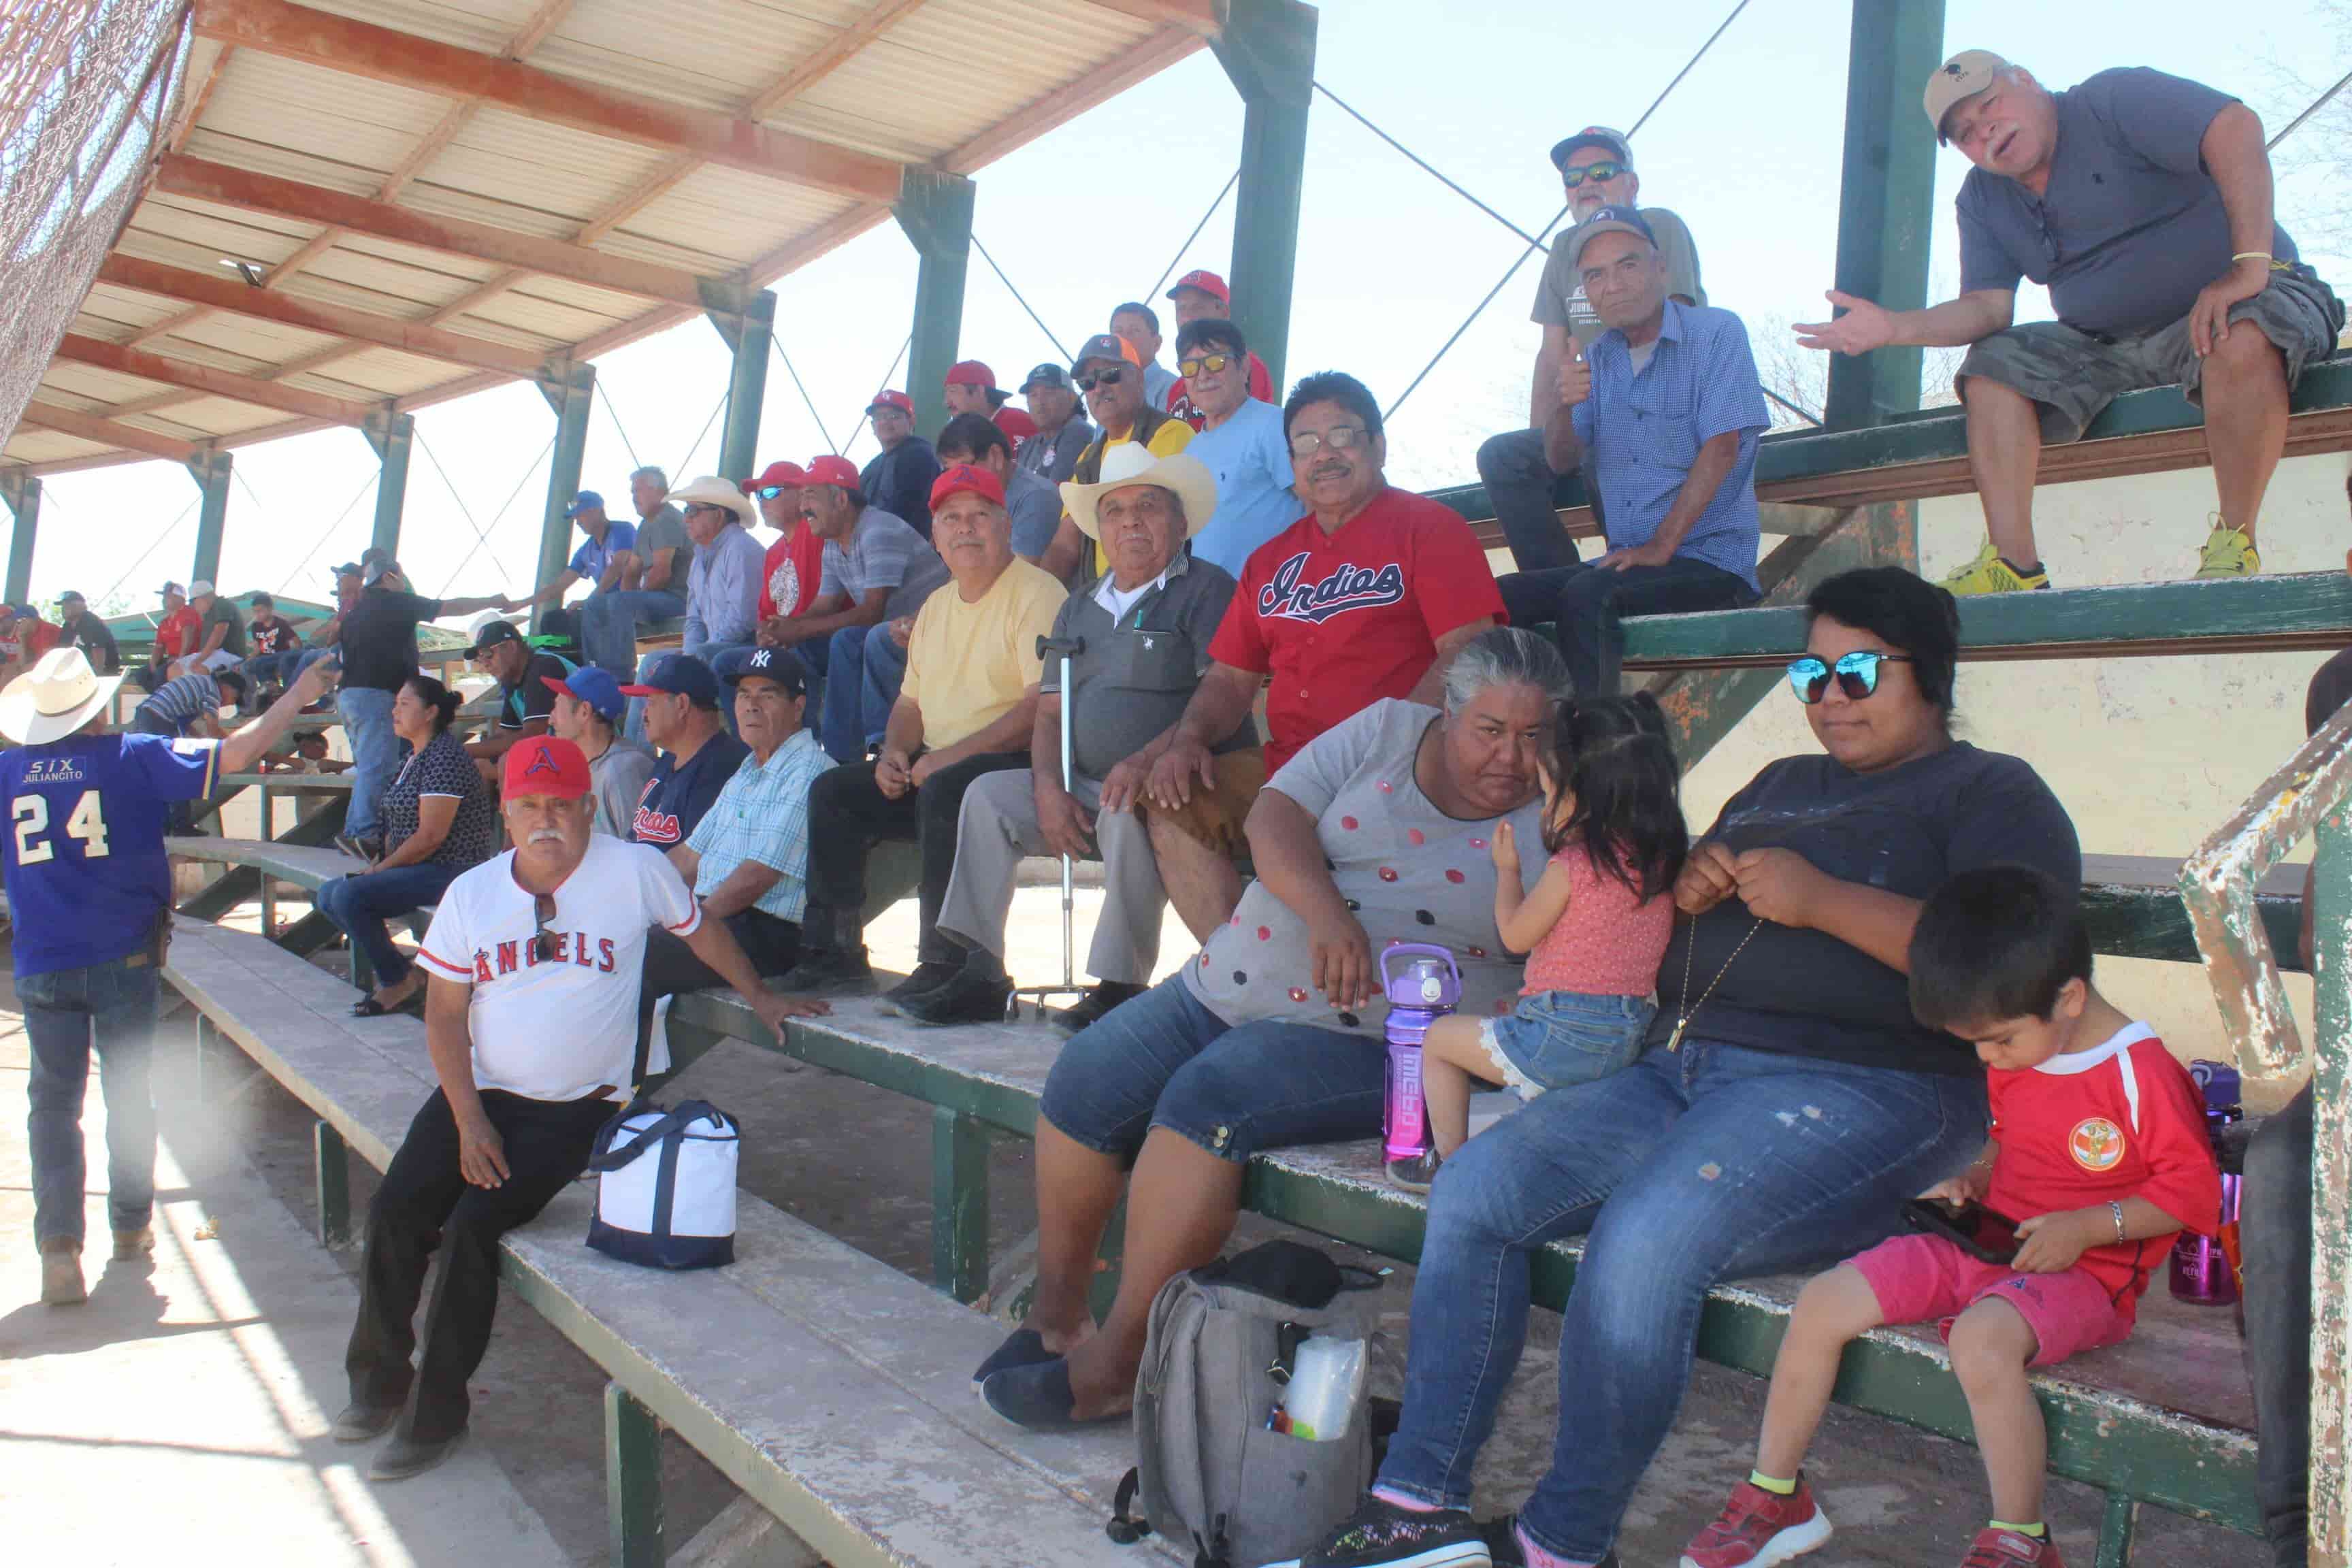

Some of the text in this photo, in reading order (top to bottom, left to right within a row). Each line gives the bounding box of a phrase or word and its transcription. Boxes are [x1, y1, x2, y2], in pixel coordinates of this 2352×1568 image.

[29, 758, 73, 774] SIX
[22, 770, 82, 783] JULIANCITO
[12, 789, 110, 866] 24
